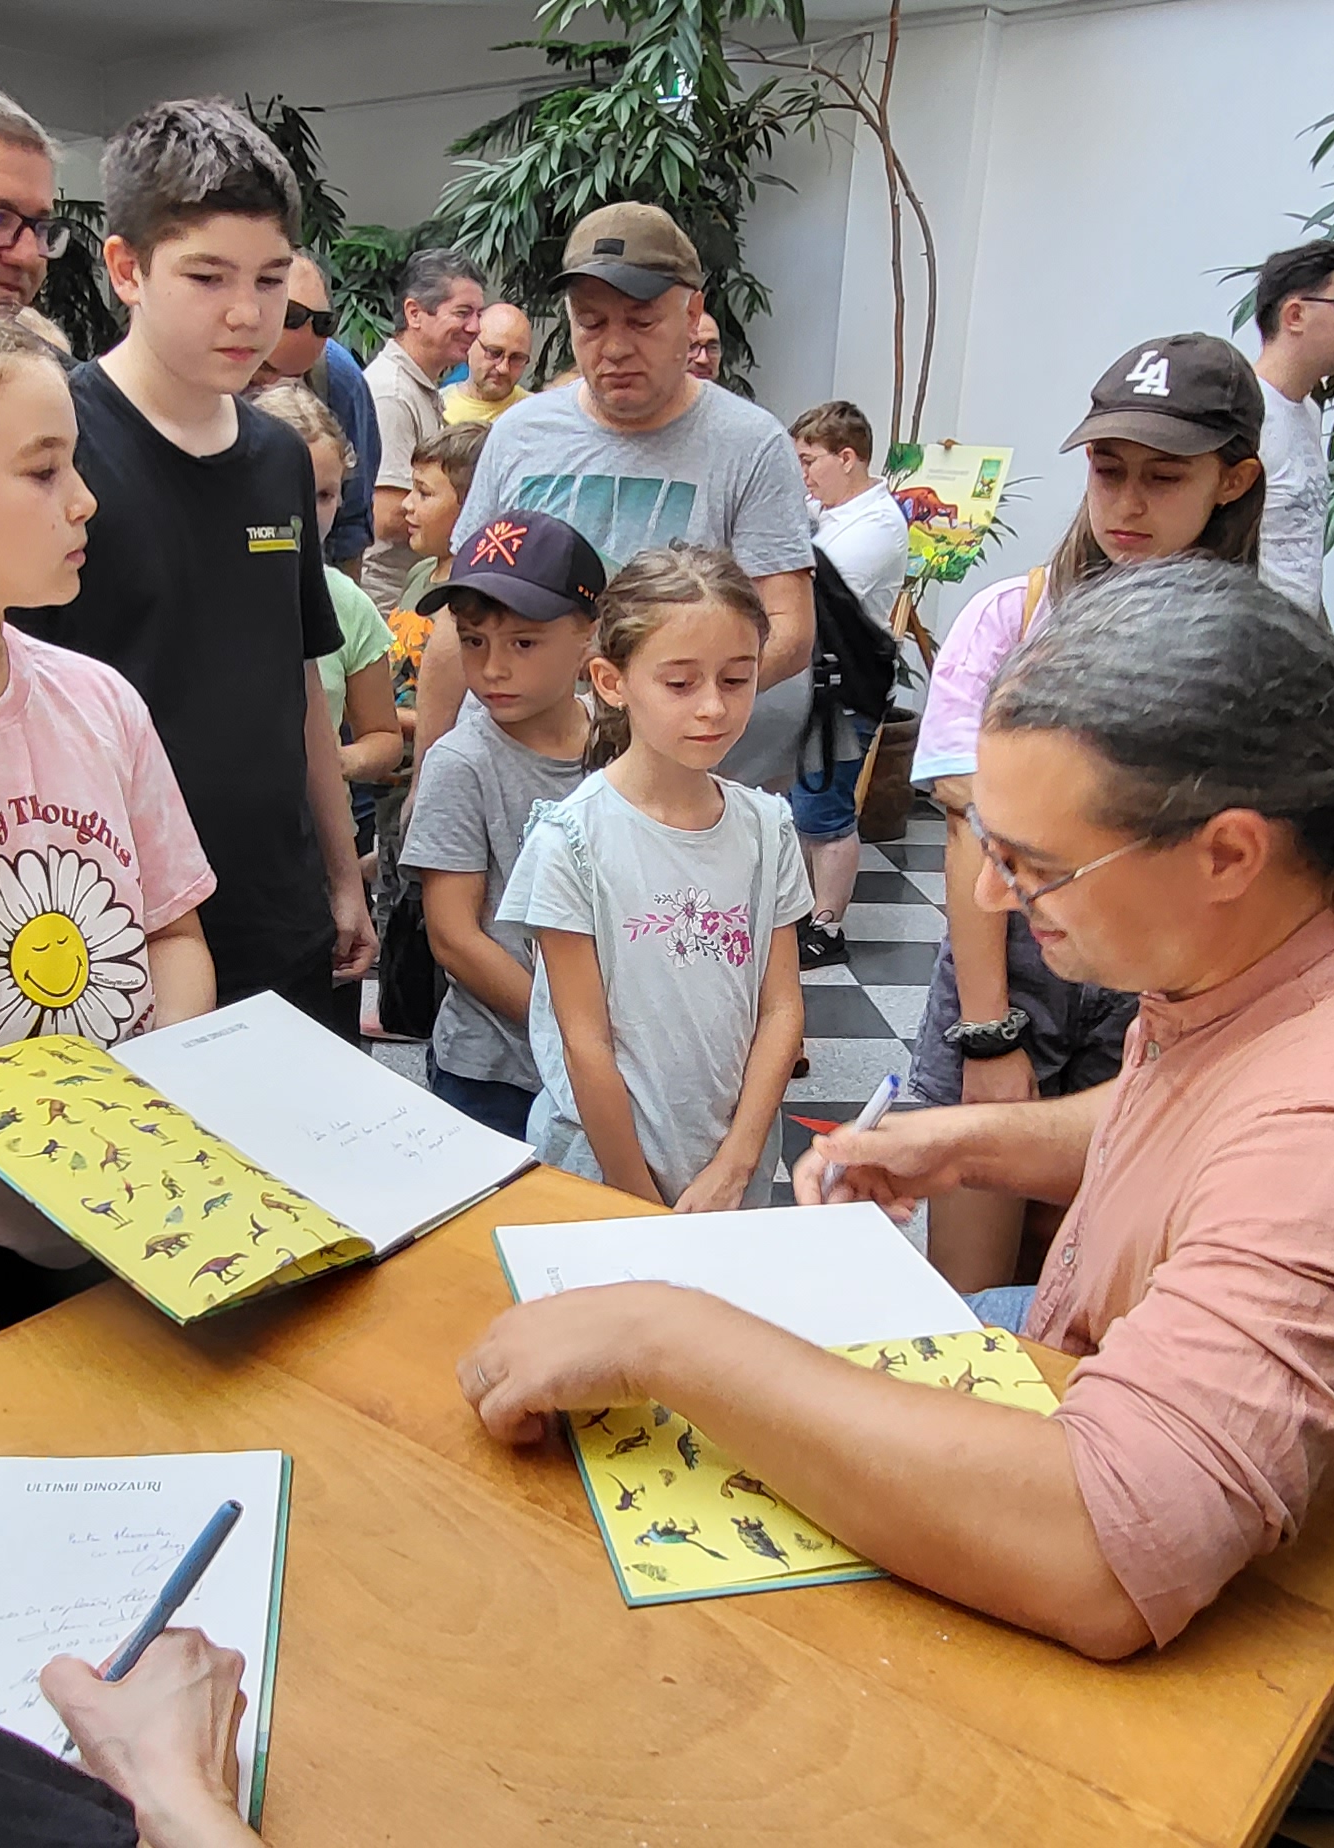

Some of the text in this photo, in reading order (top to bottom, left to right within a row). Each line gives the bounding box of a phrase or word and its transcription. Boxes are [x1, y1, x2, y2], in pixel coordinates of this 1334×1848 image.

[1125, 350, 1171, 397] LA
[246, 527, 276, 539] THOR
[26, 1480, 162, 1493] ULTIMII DINOZAURI
